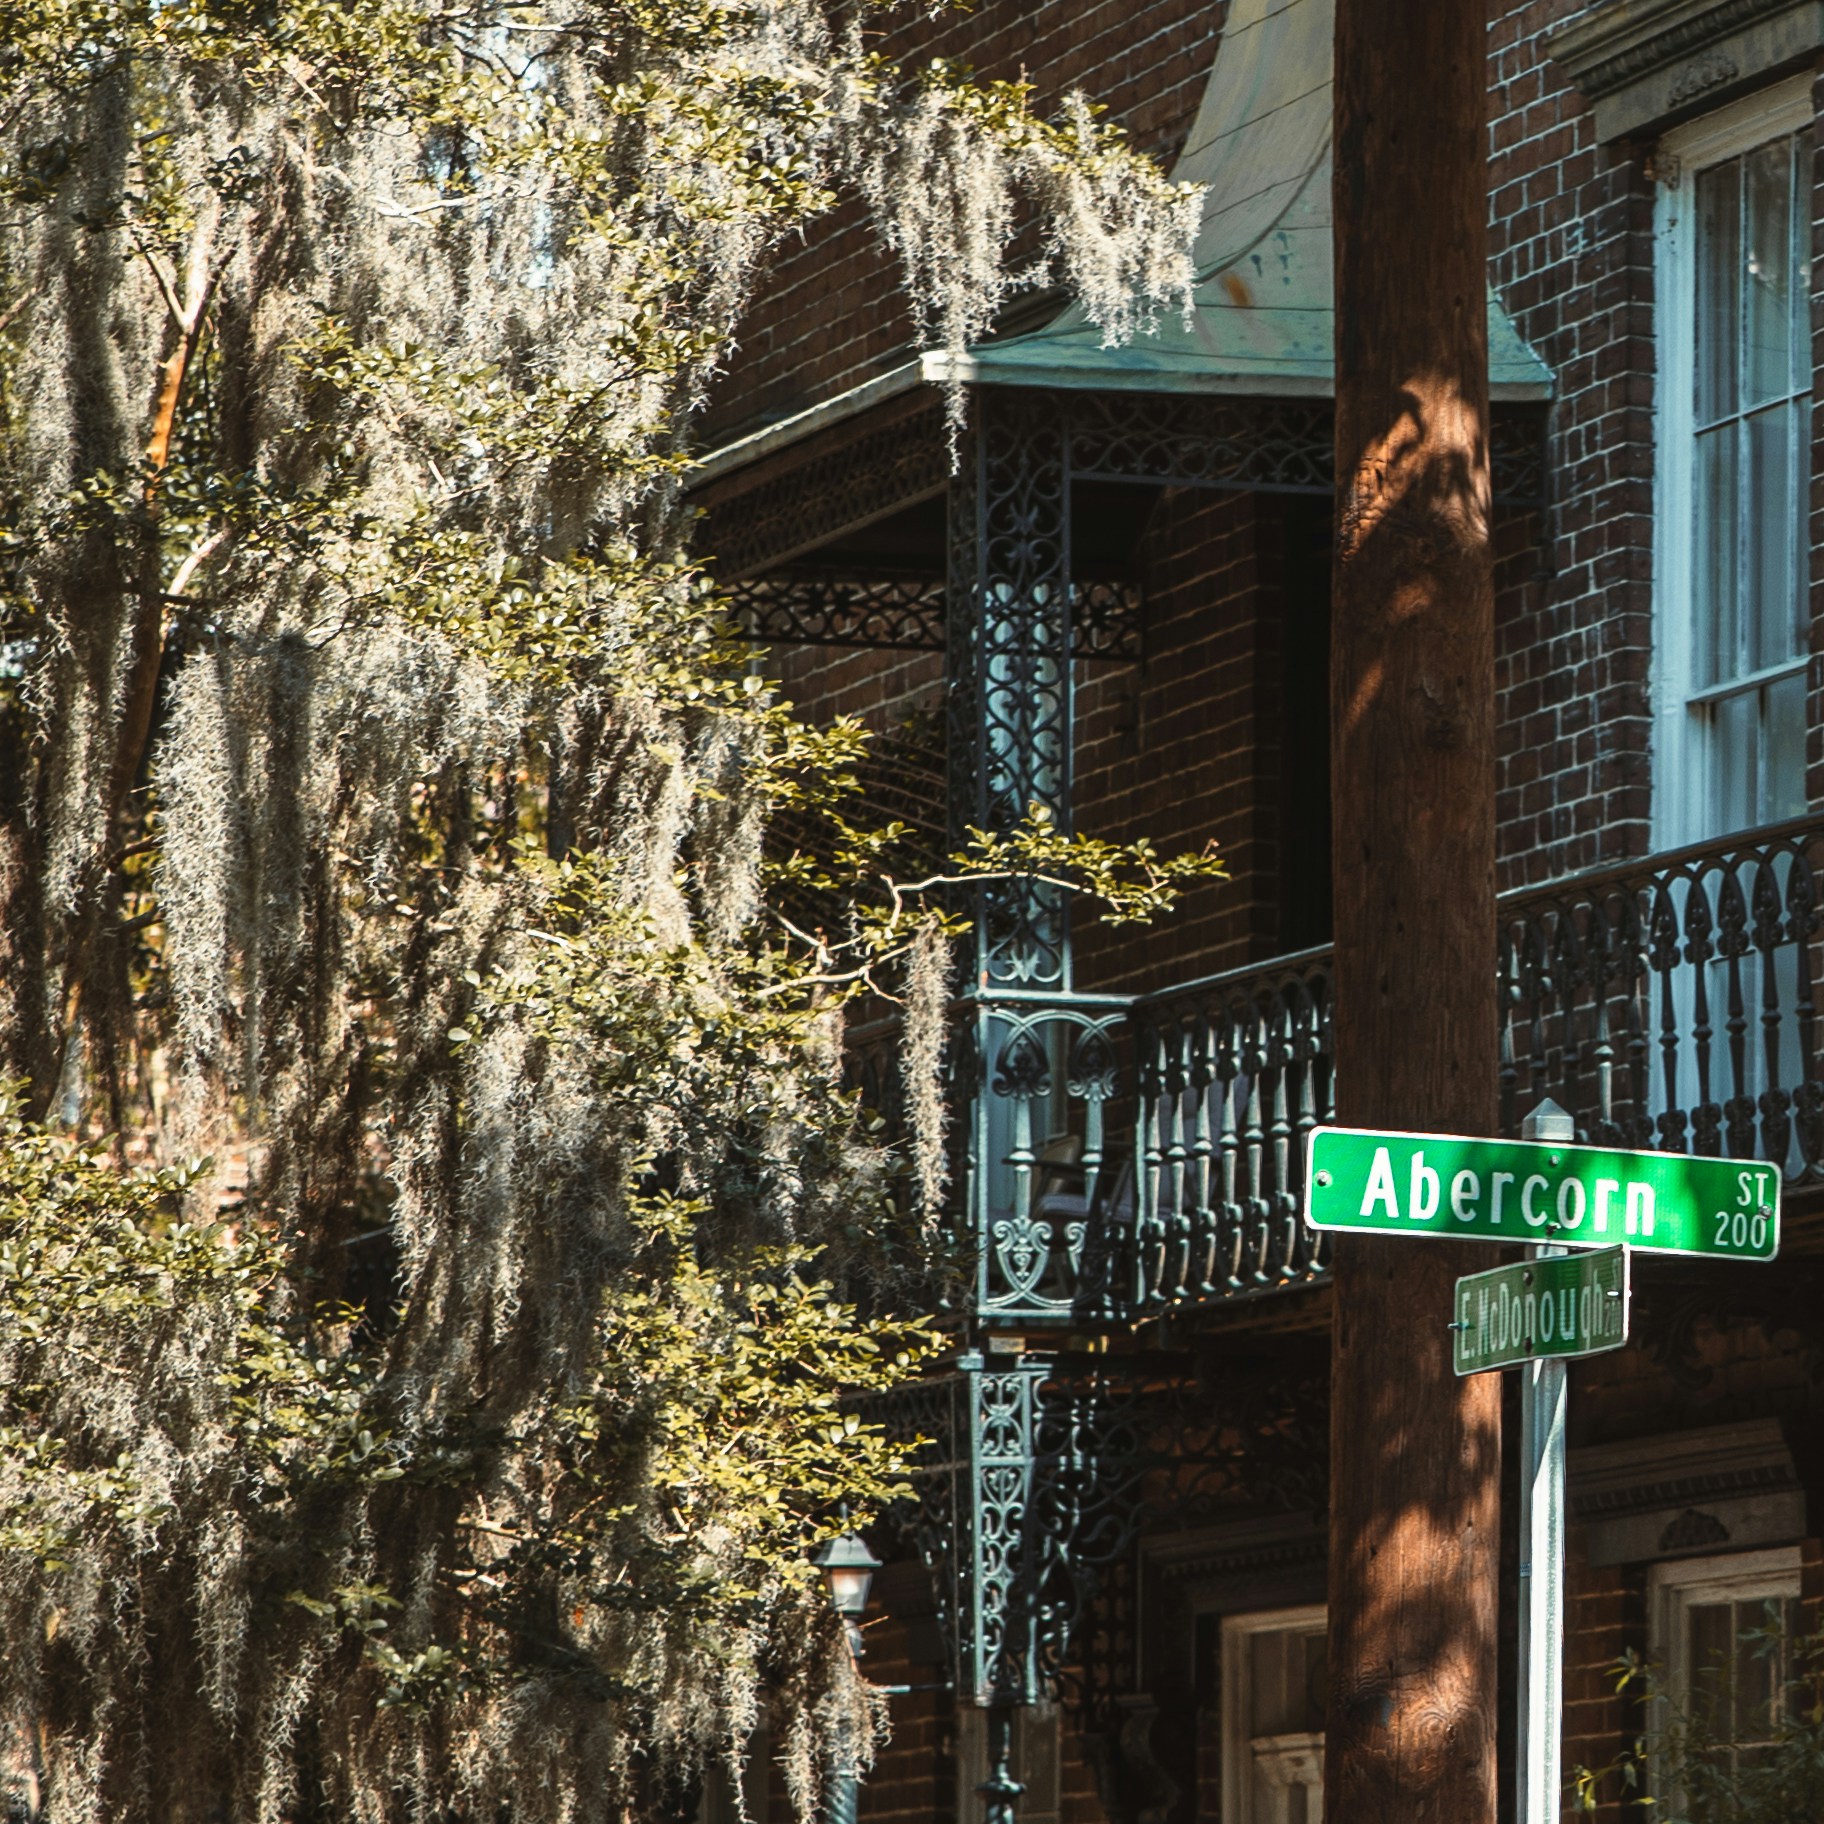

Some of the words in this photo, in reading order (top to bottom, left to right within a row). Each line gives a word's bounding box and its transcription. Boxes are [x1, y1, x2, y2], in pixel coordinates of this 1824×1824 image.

[1359, 1147, 1656, 1237] Abercorn
[1737, 1171, 1769, 1207] ST
[1714, 1210, 1767, 1249] 200
